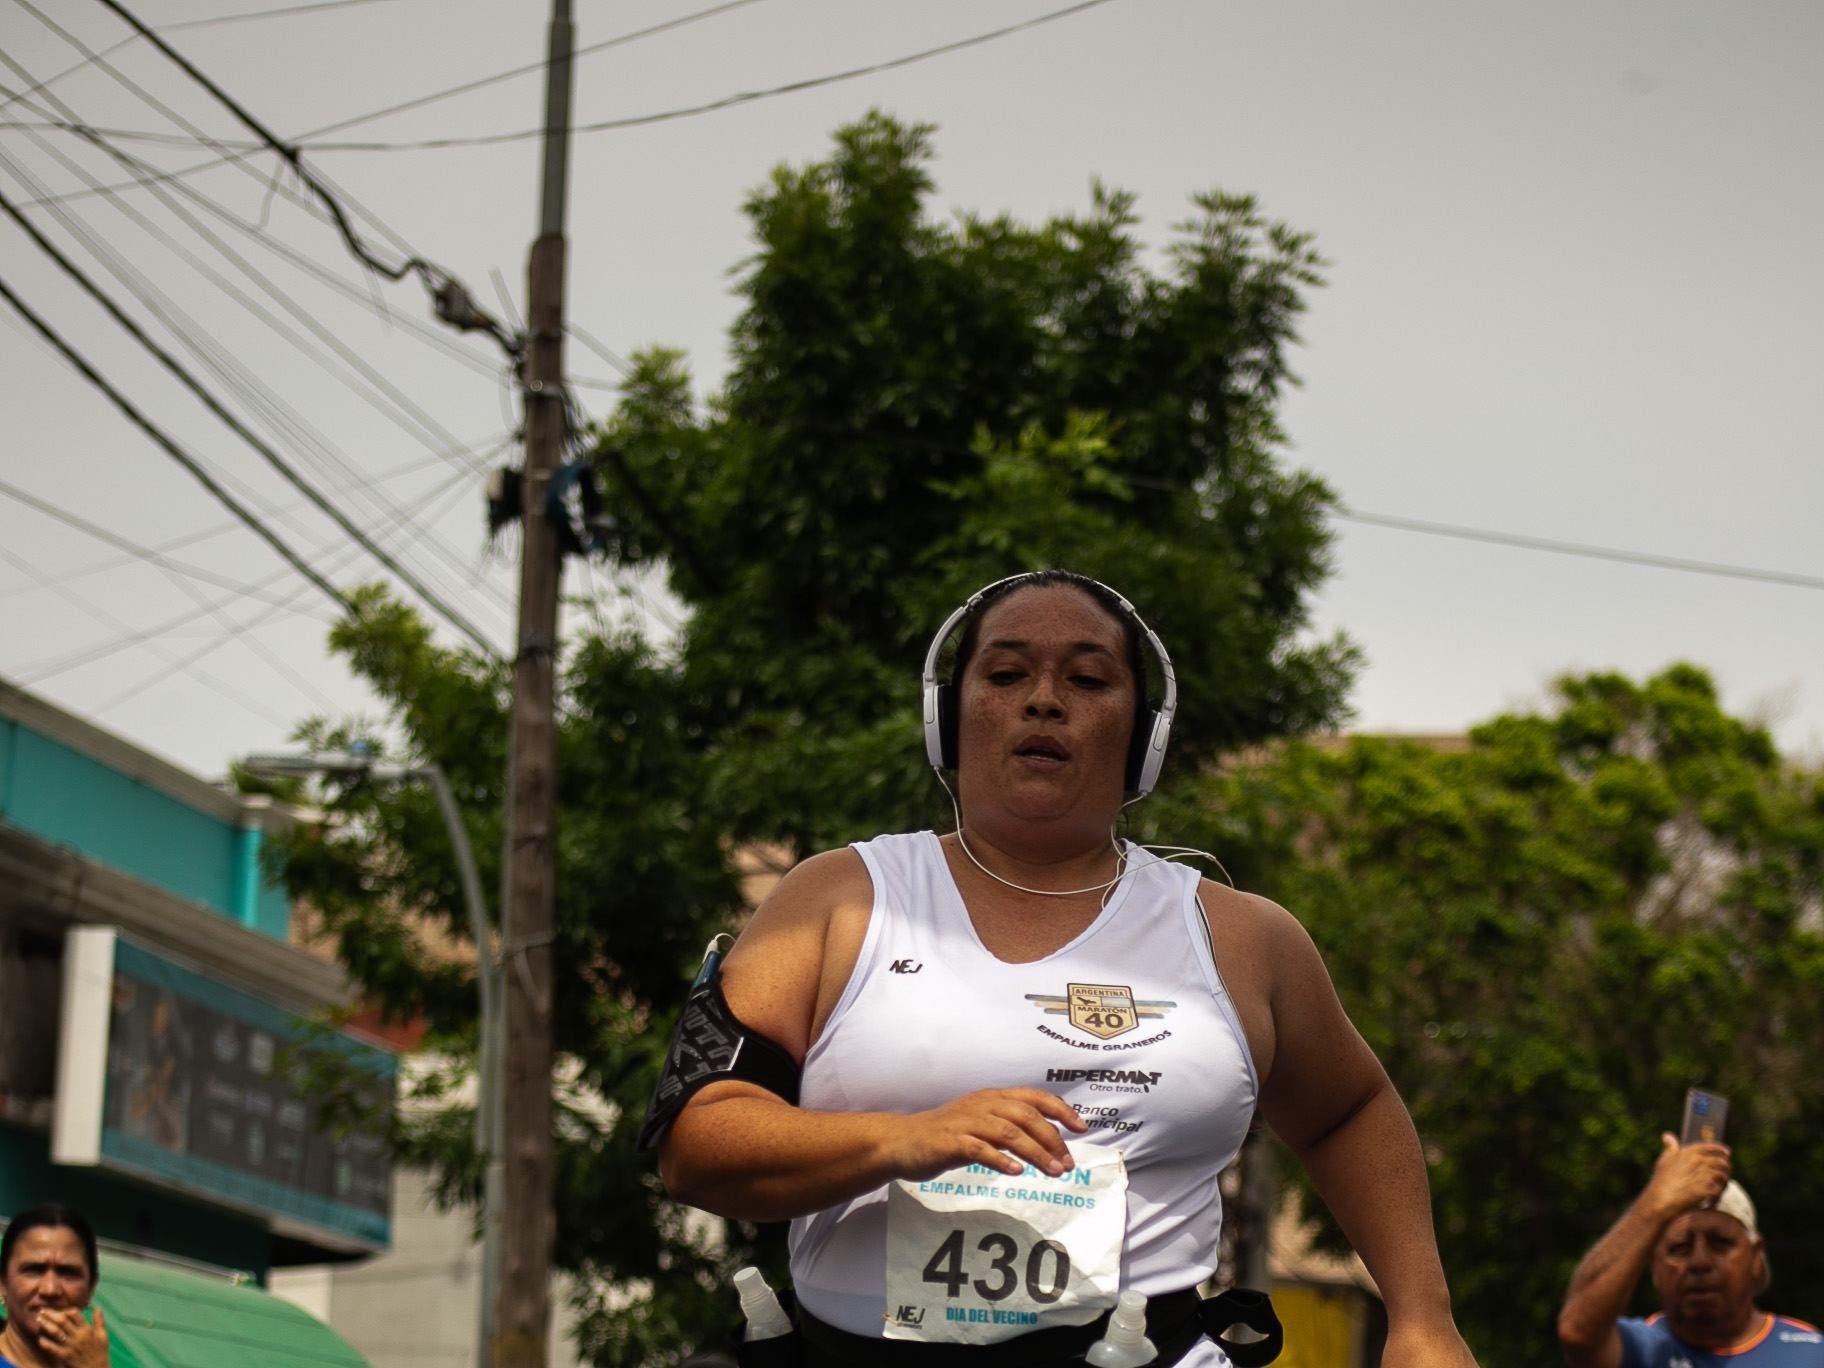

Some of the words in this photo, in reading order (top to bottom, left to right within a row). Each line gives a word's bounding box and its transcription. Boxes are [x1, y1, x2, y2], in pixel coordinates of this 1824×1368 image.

[1075, 988, 1125, 998] ARGENTINA
[1084, 1012, 1124, 1029] 40
[1036, 1024, 1099, 1051] EMPALME
[1102, 1030, 1172, 1051] GRANEROS
[1089, 1083, 1113, 1092] Otro
[1071, 1103, 1119, 1117] Banco
[1085, 1117, 1144, 1133] unicipal
[919, 1181, 1000, 1198] EMPALME
[1005, 1187, 1096, 1210] GRANEROS
[922, 1229, 1070, 1304] 430
[896, 1305, 926, 1325] NEJ
[946, 1307, 967, 1322] DIA
[968, 1308, 989, 1323] DEL
[992, 1310, 1038, 1325] VECINO
